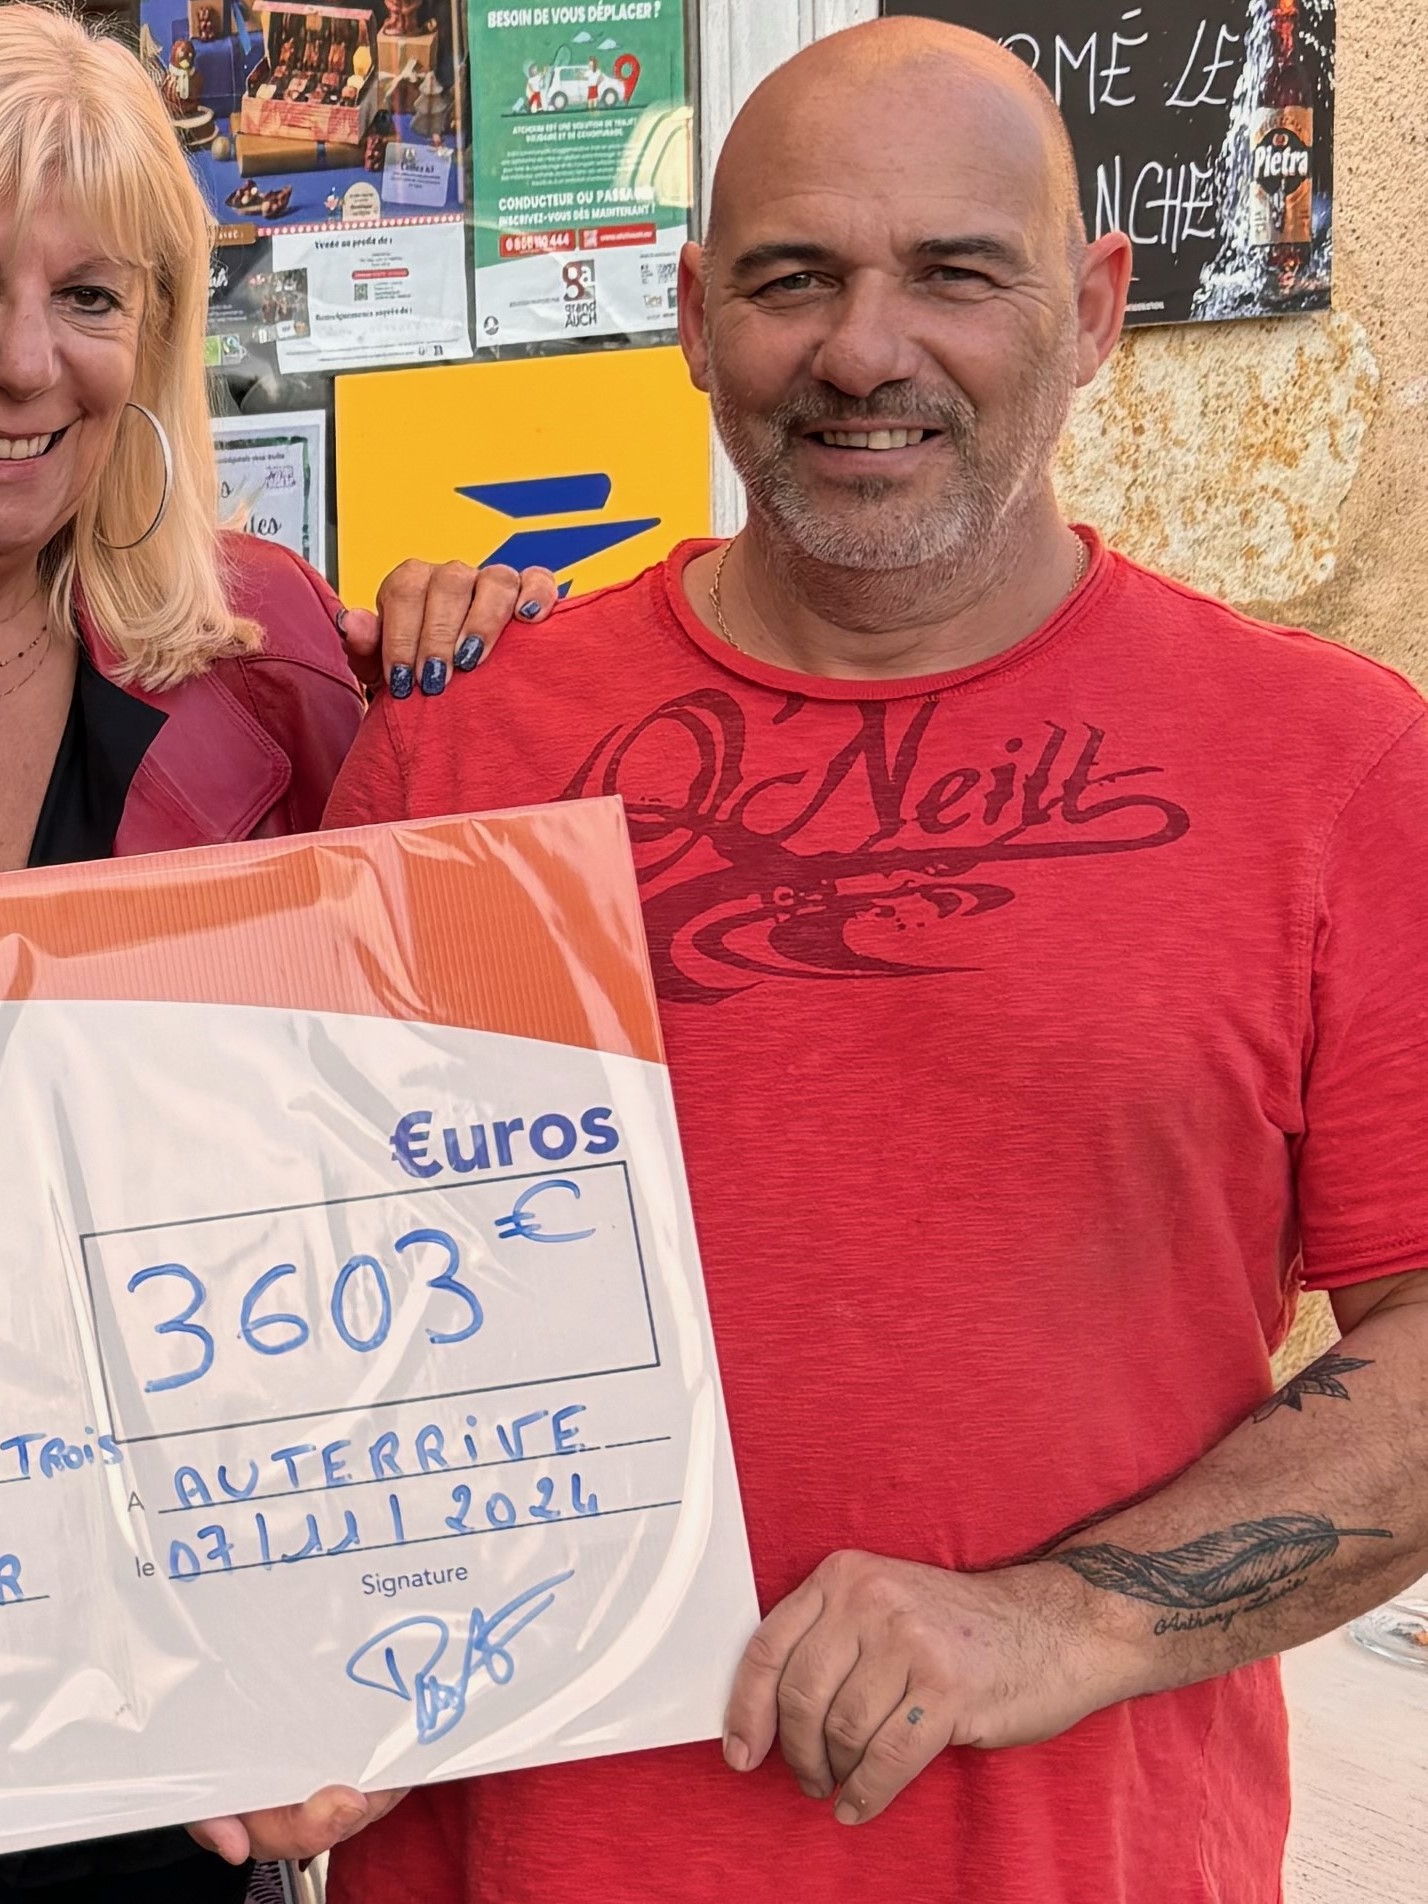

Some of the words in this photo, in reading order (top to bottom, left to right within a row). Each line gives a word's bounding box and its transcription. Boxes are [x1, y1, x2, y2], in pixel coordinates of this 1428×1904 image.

[487, 8, 533, 28] BESOIN
[533, 7, 551, 26] DE
[551, 4, 586, 24] VOUS
[1165, 18, 1240, 108] LE
[1252, 145, 1309, 178] Pietra
[498, 191, 575, 211] CONDUCTEUR
[576, 190, 594, 205] OU
[564, 300, 597, 314] grand
[564, 312, 598, 329] AUCH
[126, 1228, 484, 1394] 3603
[494, 1179, 596, 1243] €
[128, 1494, 145, 1513] A
[135, 1557, 156, 1579] le
[360, 1563, 469, 1596] Signature
